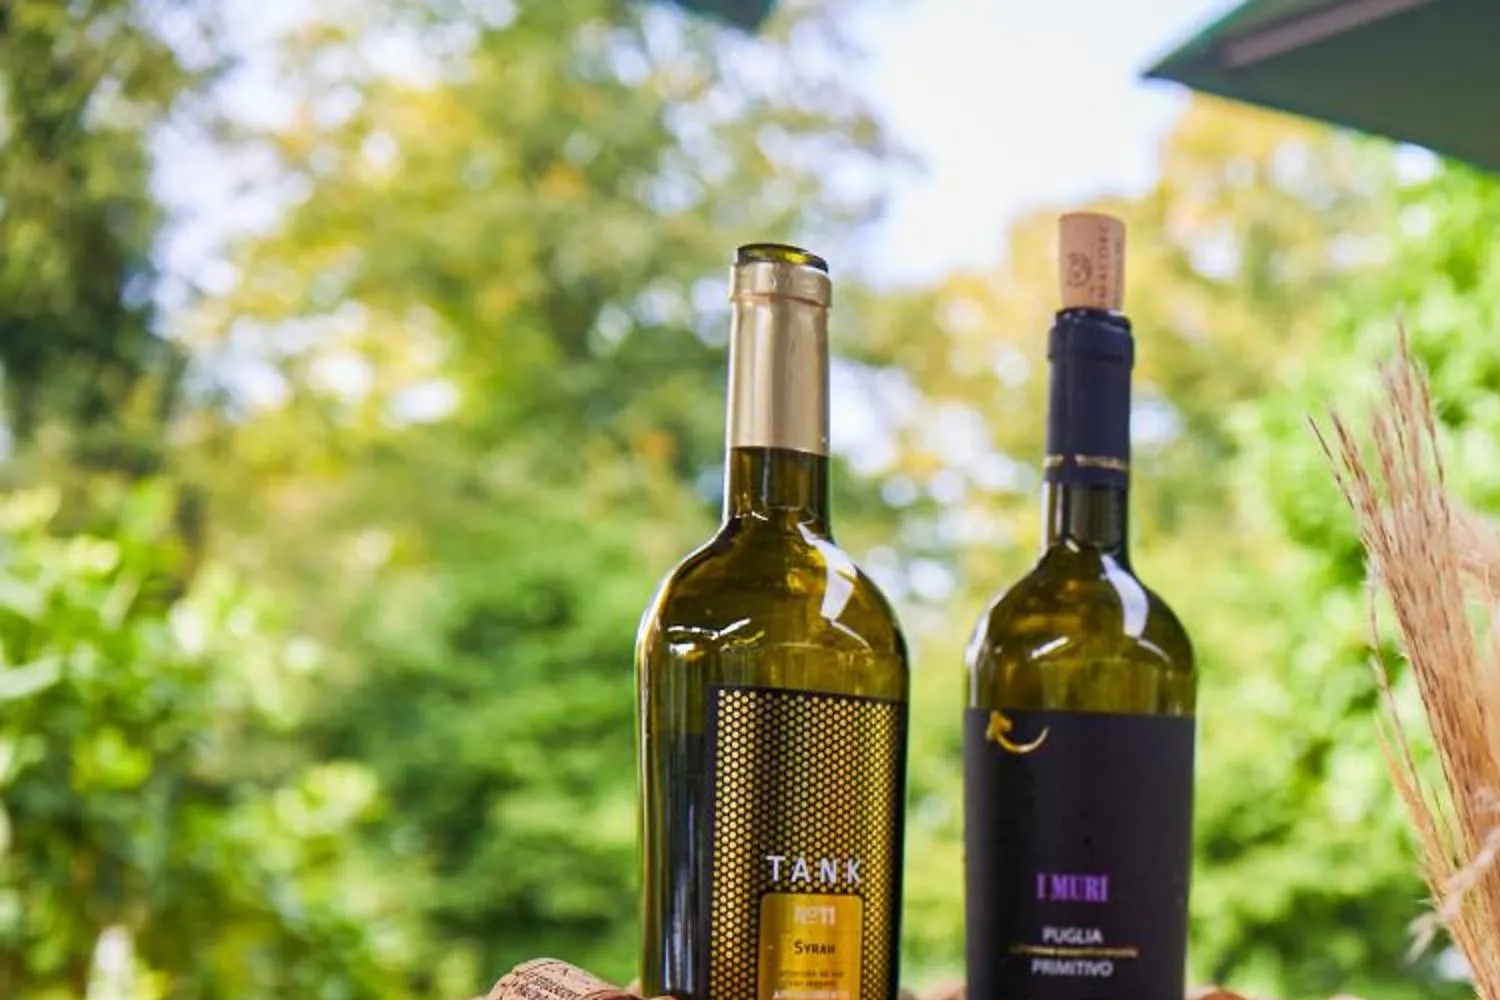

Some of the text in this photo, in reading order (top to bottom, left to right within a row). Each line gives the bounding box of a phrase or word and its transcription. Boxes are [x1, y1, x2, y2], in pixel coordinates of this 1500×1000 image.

[765, 854, 862, 885] TANK
[1051, 873, 1108, 902] MURI
[1042, 926, 1103, 945] PUGLIA
[1031, 958, 1114, 978] PRIMITIVO
